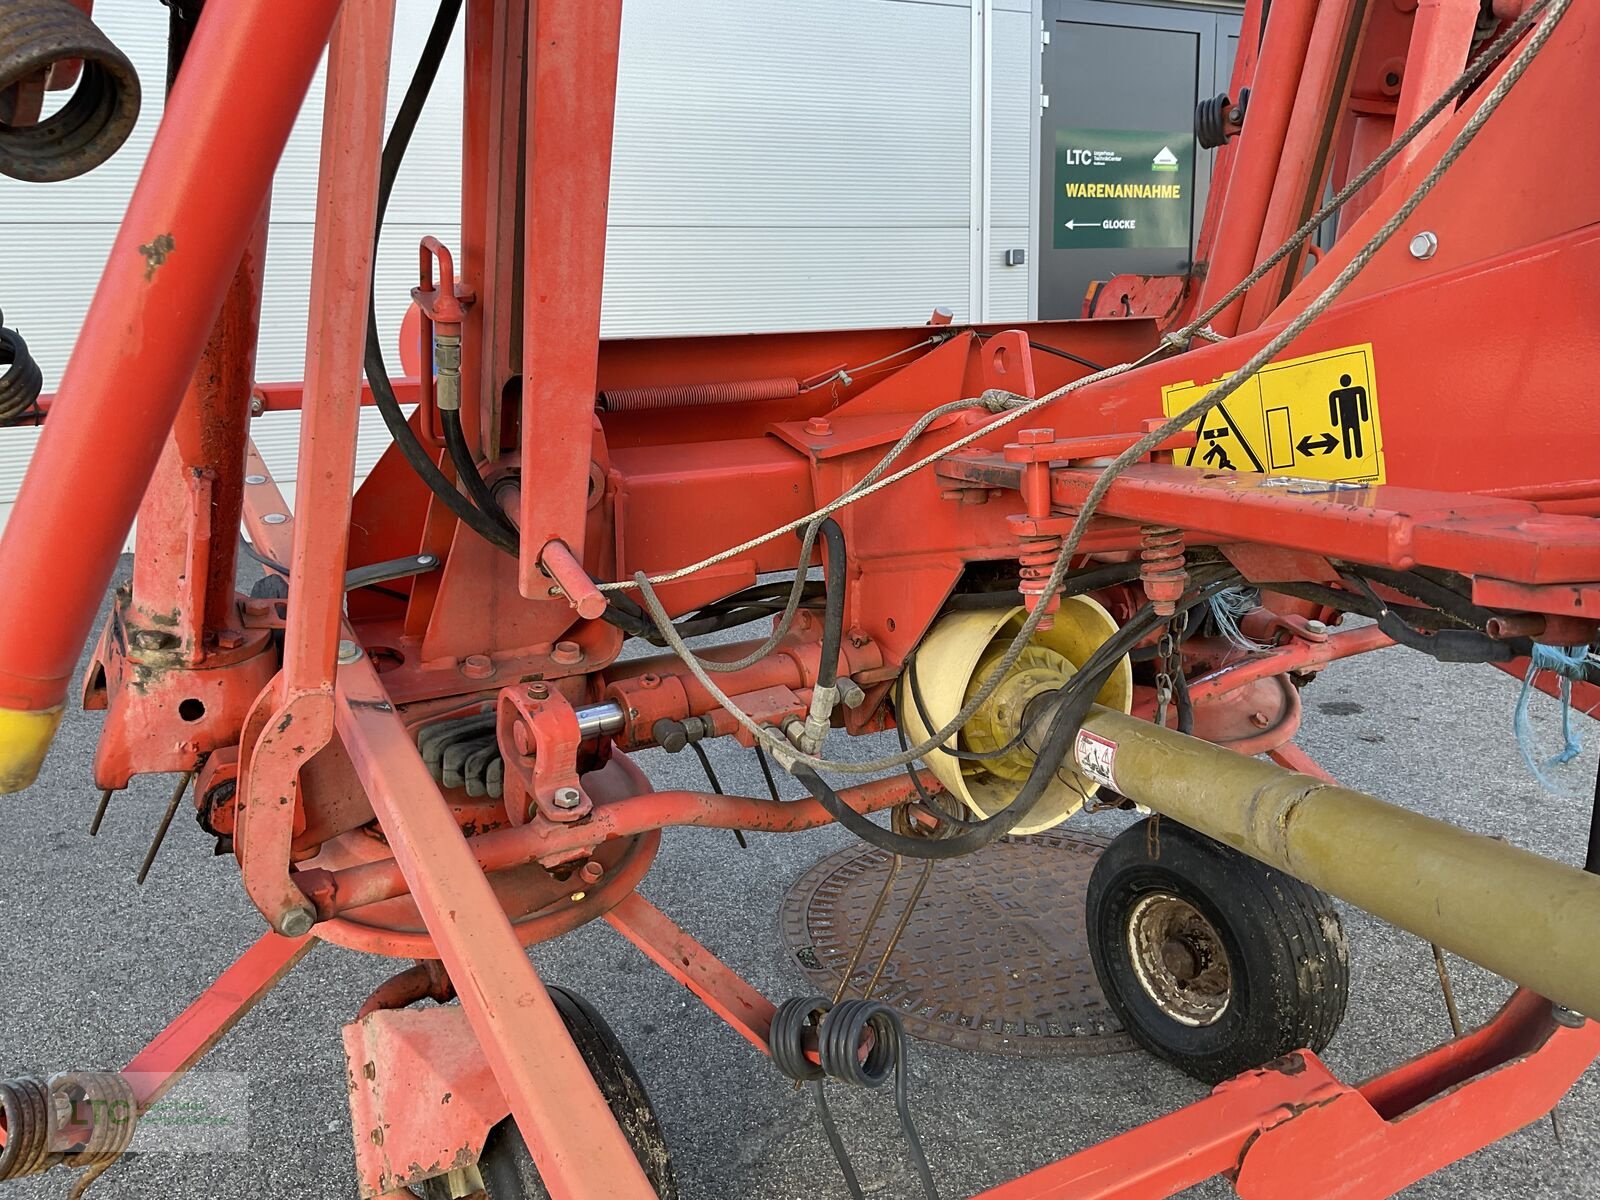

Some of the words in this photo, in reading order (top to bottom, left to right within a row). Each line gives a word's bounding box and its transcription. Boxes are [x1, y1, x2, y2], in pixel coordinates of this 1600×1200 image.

[1066, 149, 1092, 165] LTC
[1065, 183, 1181, 199] WARENANNAHME
[1102, 219, 1136, 229] GLOCKE
